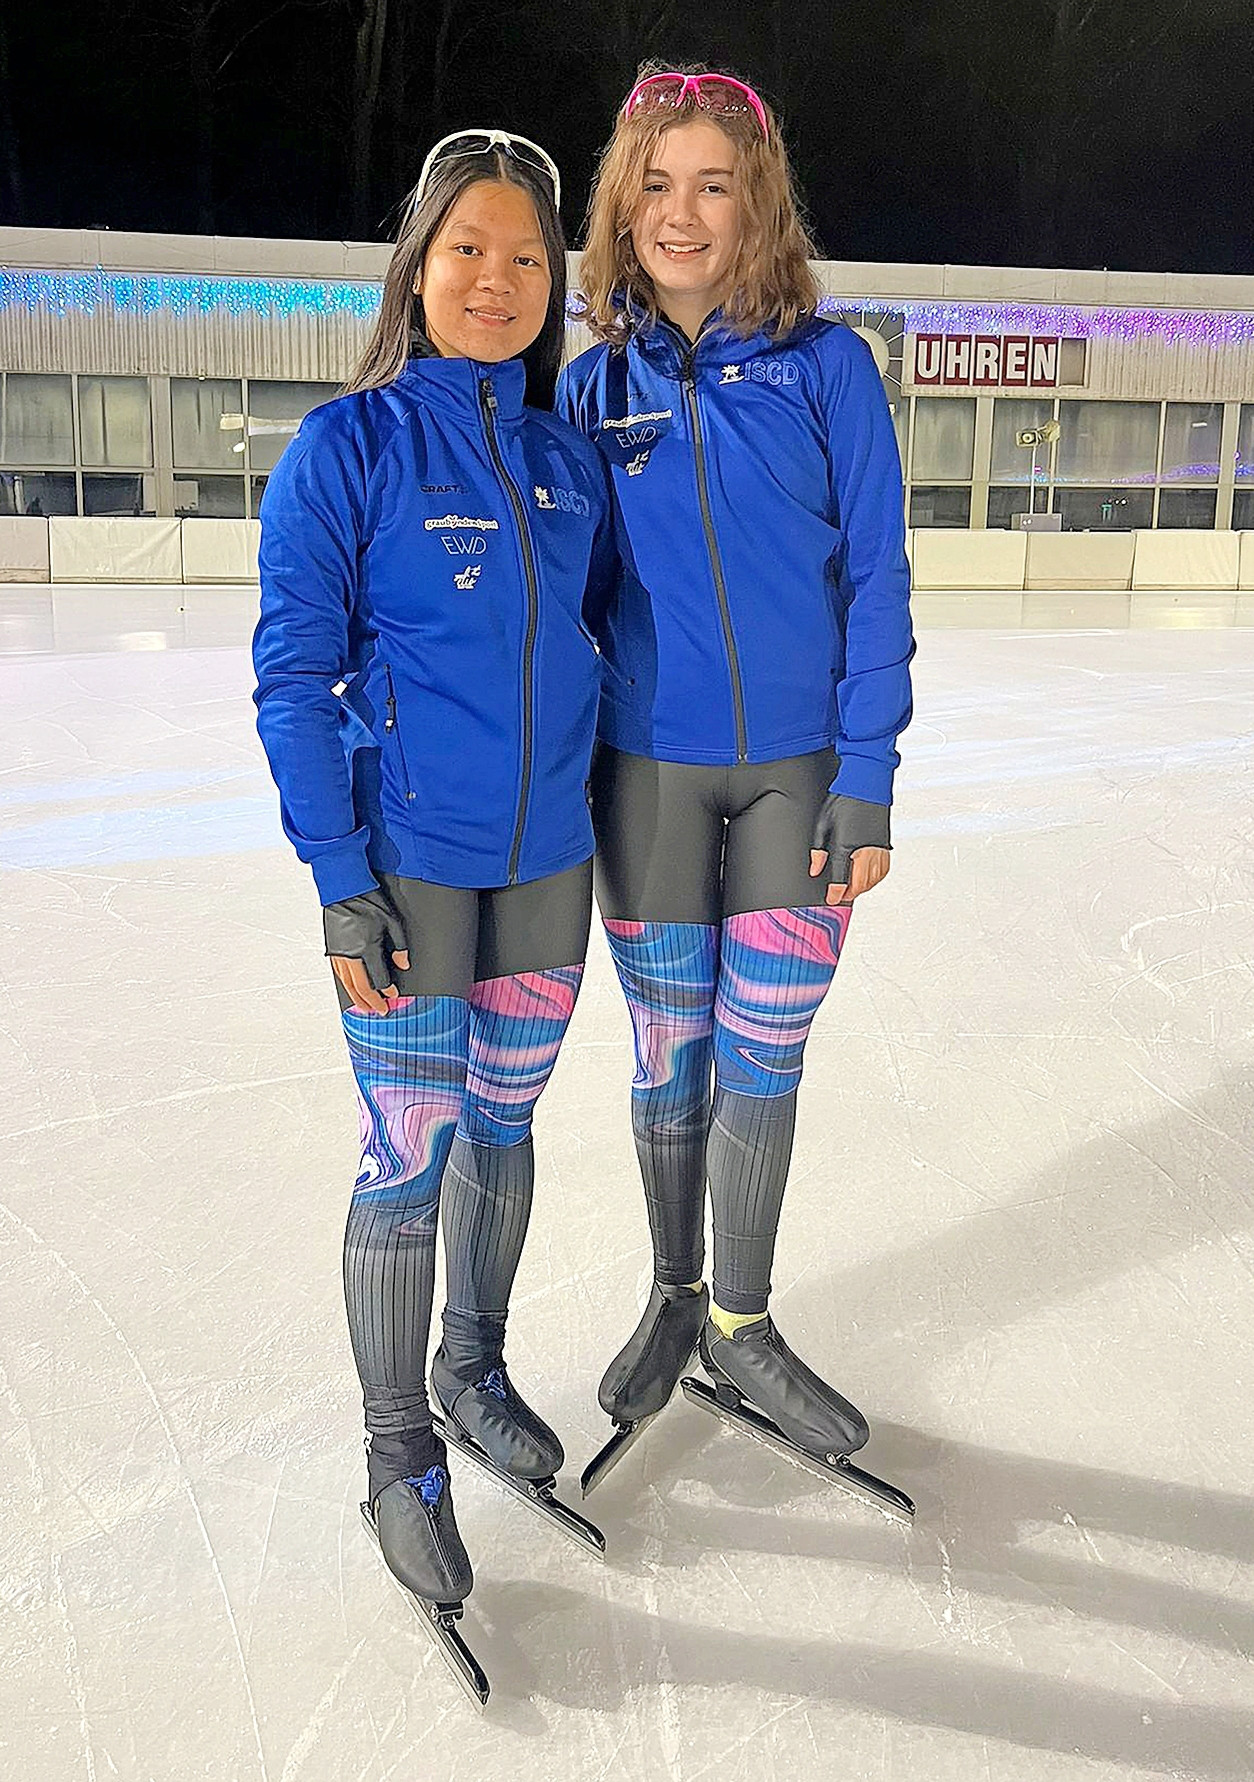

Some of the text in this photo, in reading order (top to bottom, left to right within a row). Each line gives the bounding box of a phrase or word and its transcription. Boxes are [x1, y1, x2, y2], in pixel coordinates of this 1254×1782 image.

[917, 340, 1057, 381] UHREN
[745, 361, 800, 386] ISCD
[616, 426, 657, 448] EWD
[420, 484, 460, 493] CRAFT
[441, 536, 487, 555] EWD
